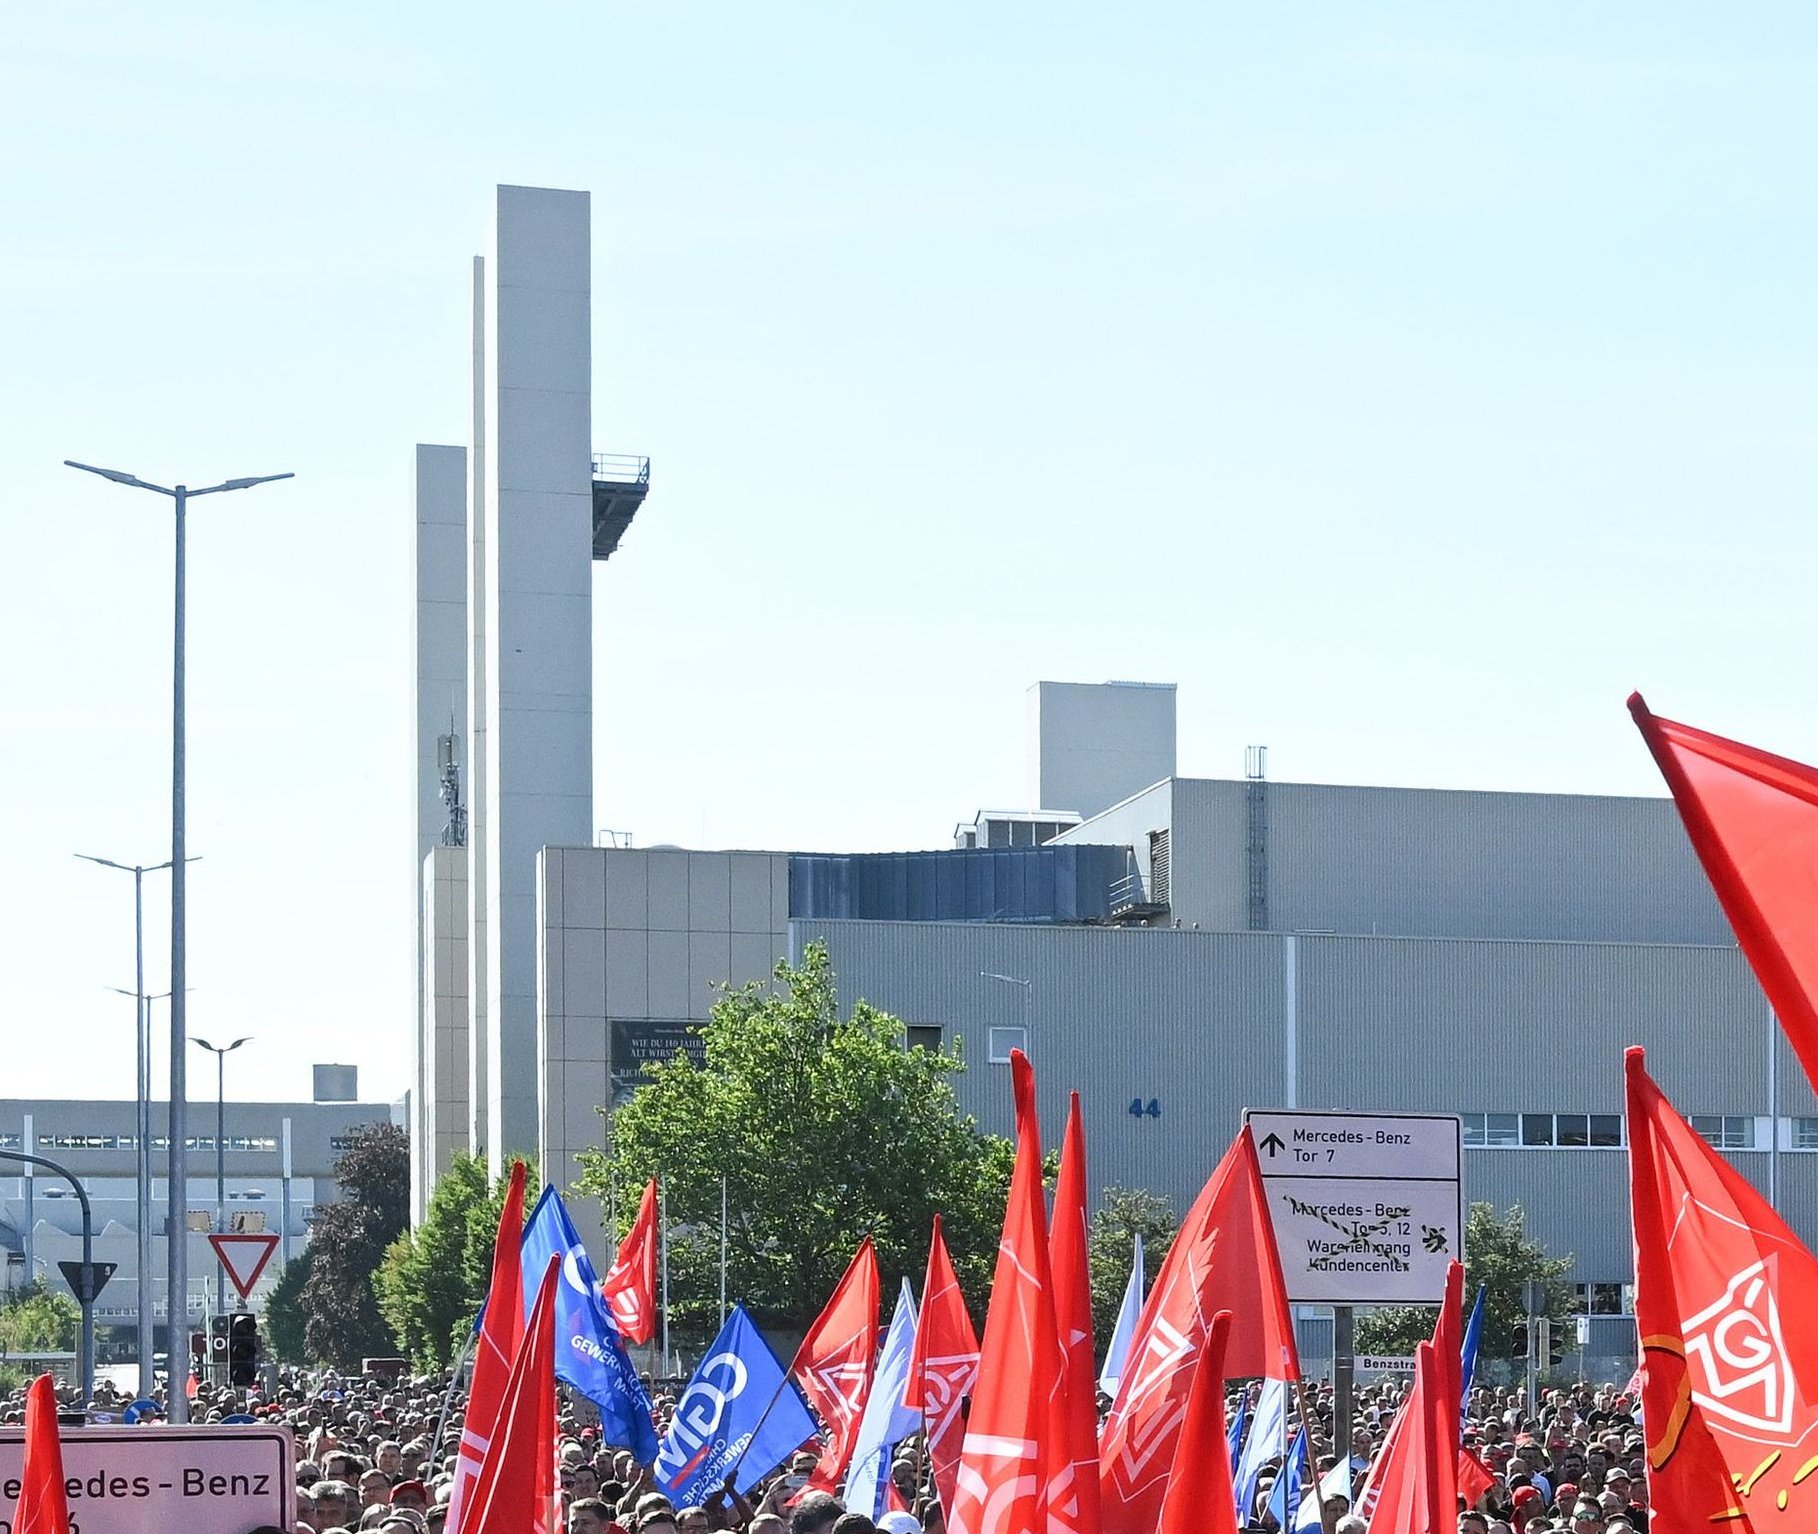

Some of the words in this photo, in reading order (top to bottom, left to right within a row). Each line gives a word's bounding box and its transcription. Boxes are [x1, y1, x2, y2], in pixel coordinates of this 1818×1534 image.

[1129, 1098, 1161, 1118] 44
[1293, 1149, 1319, 1162] Tor
[1326, 1150, 1335, 1162] 7
[1398, 1222, 1411, 1235] 12
[1363, 1358, 1416, 1370] Benzstra
